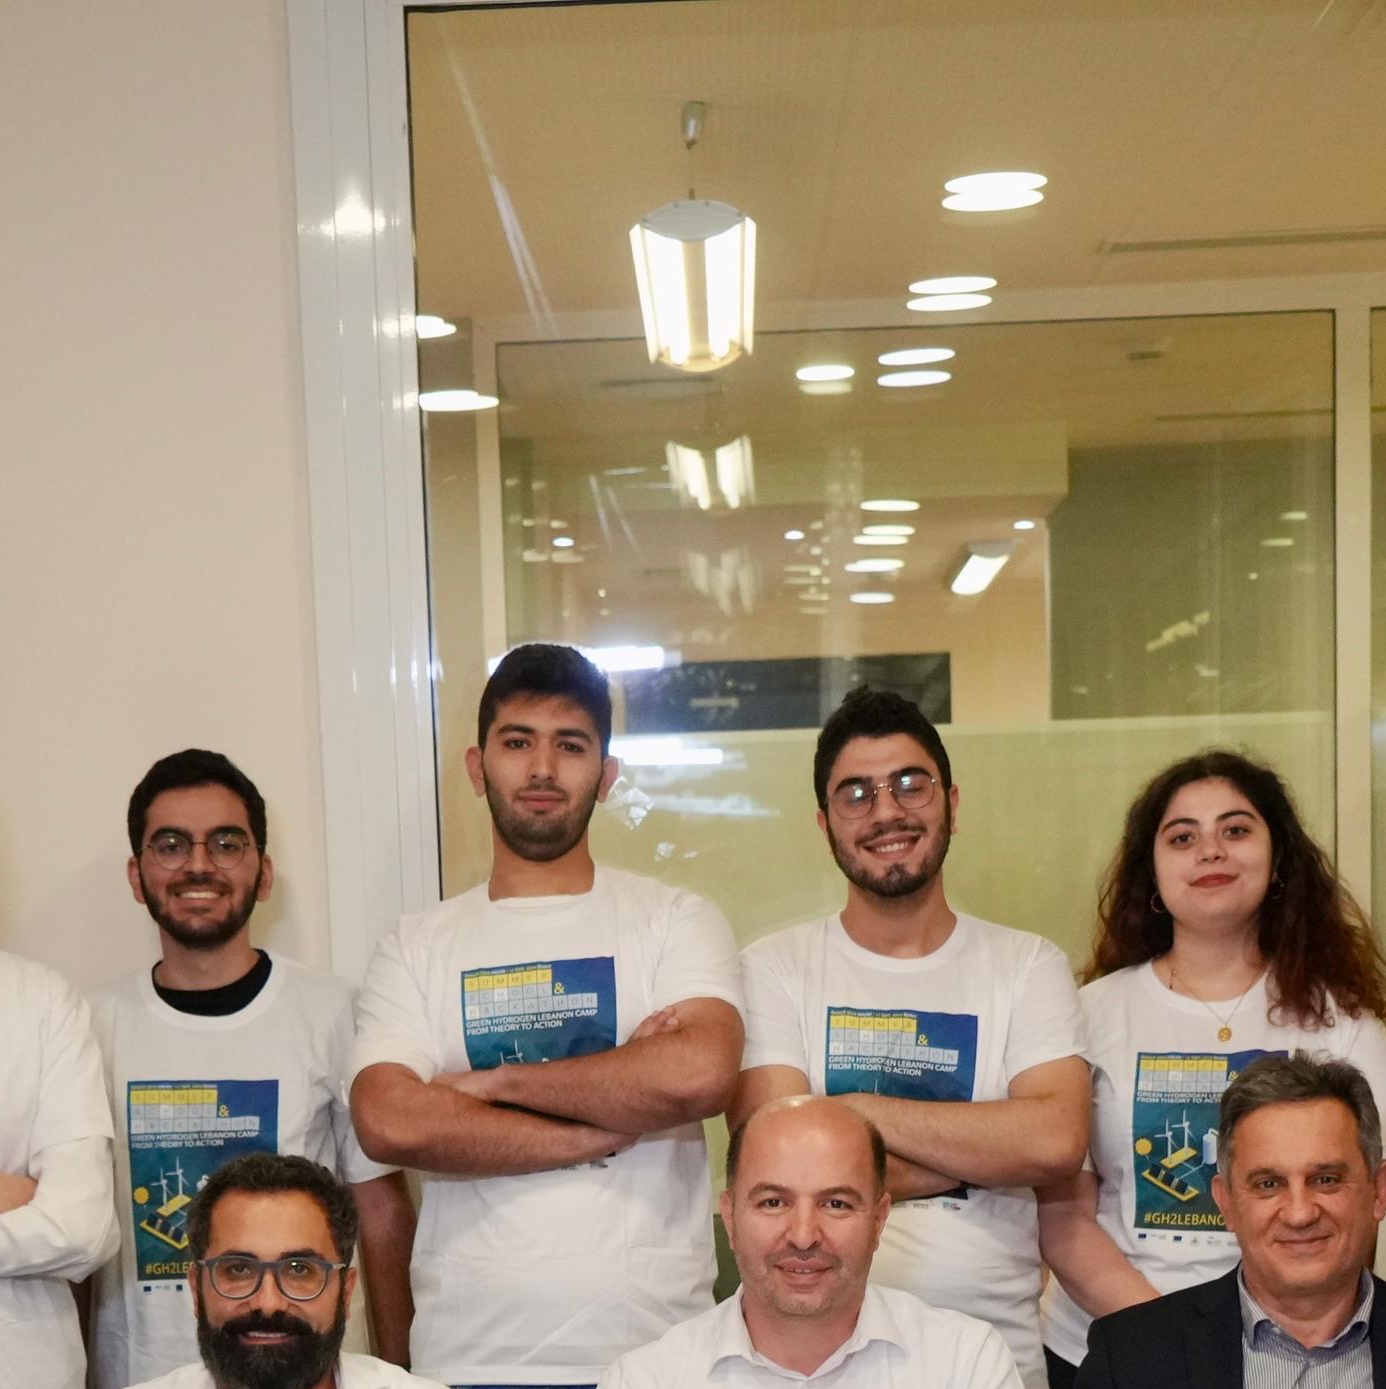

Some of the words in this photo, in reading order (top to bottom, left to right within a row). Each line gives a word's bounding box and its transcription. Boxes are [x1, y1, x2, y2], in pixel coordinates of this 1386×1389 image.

[553, 982, 564, 994] &
[466, 1019, 492, 1029] GREEN
[492, 1013, 537, 1026] HYDROGEN
[537, 1010, 574, 1022] LEBANON
[574, 1008, 598, 1018] CAMP
[466, 1026, 490, 1036] FROM
[489, 1024, 521, 1034] THEORY
[521, 1023, 532, 1031] TO
[533, 1020, 563, 1030] ACTION
[917, 1034, 930, 1046] &
[828, 1063, 852, 1071] FROM
[852, 1064, 883, 1072] THEORY
[892, 1067, 922, 1076] ACTION
[856, 1056, 897, 1067] HYDROGEN
[897, 1060, 934, 1071] LEBANON
[934, 1064, 958, 1073] CAMP
[1162, 1091, 1207, 1099] HYDROGEN
[218, 1104, 230, 1118] &
[131, 1134, 156, 1142] GREEN
[156, 1132, 199, 1141] HYDROGEN
[199, 1131, 236, 1139] LEBANON
[236, 1130, 259, 1138] CAMP
[154, 1140, 185, 1148] THEORY
[185, 1139, 196, 1147] TO
[195, 1139, 224, 1147] ACTION
[1143, 1212, 1226, 1226] #GH2LEBANO
